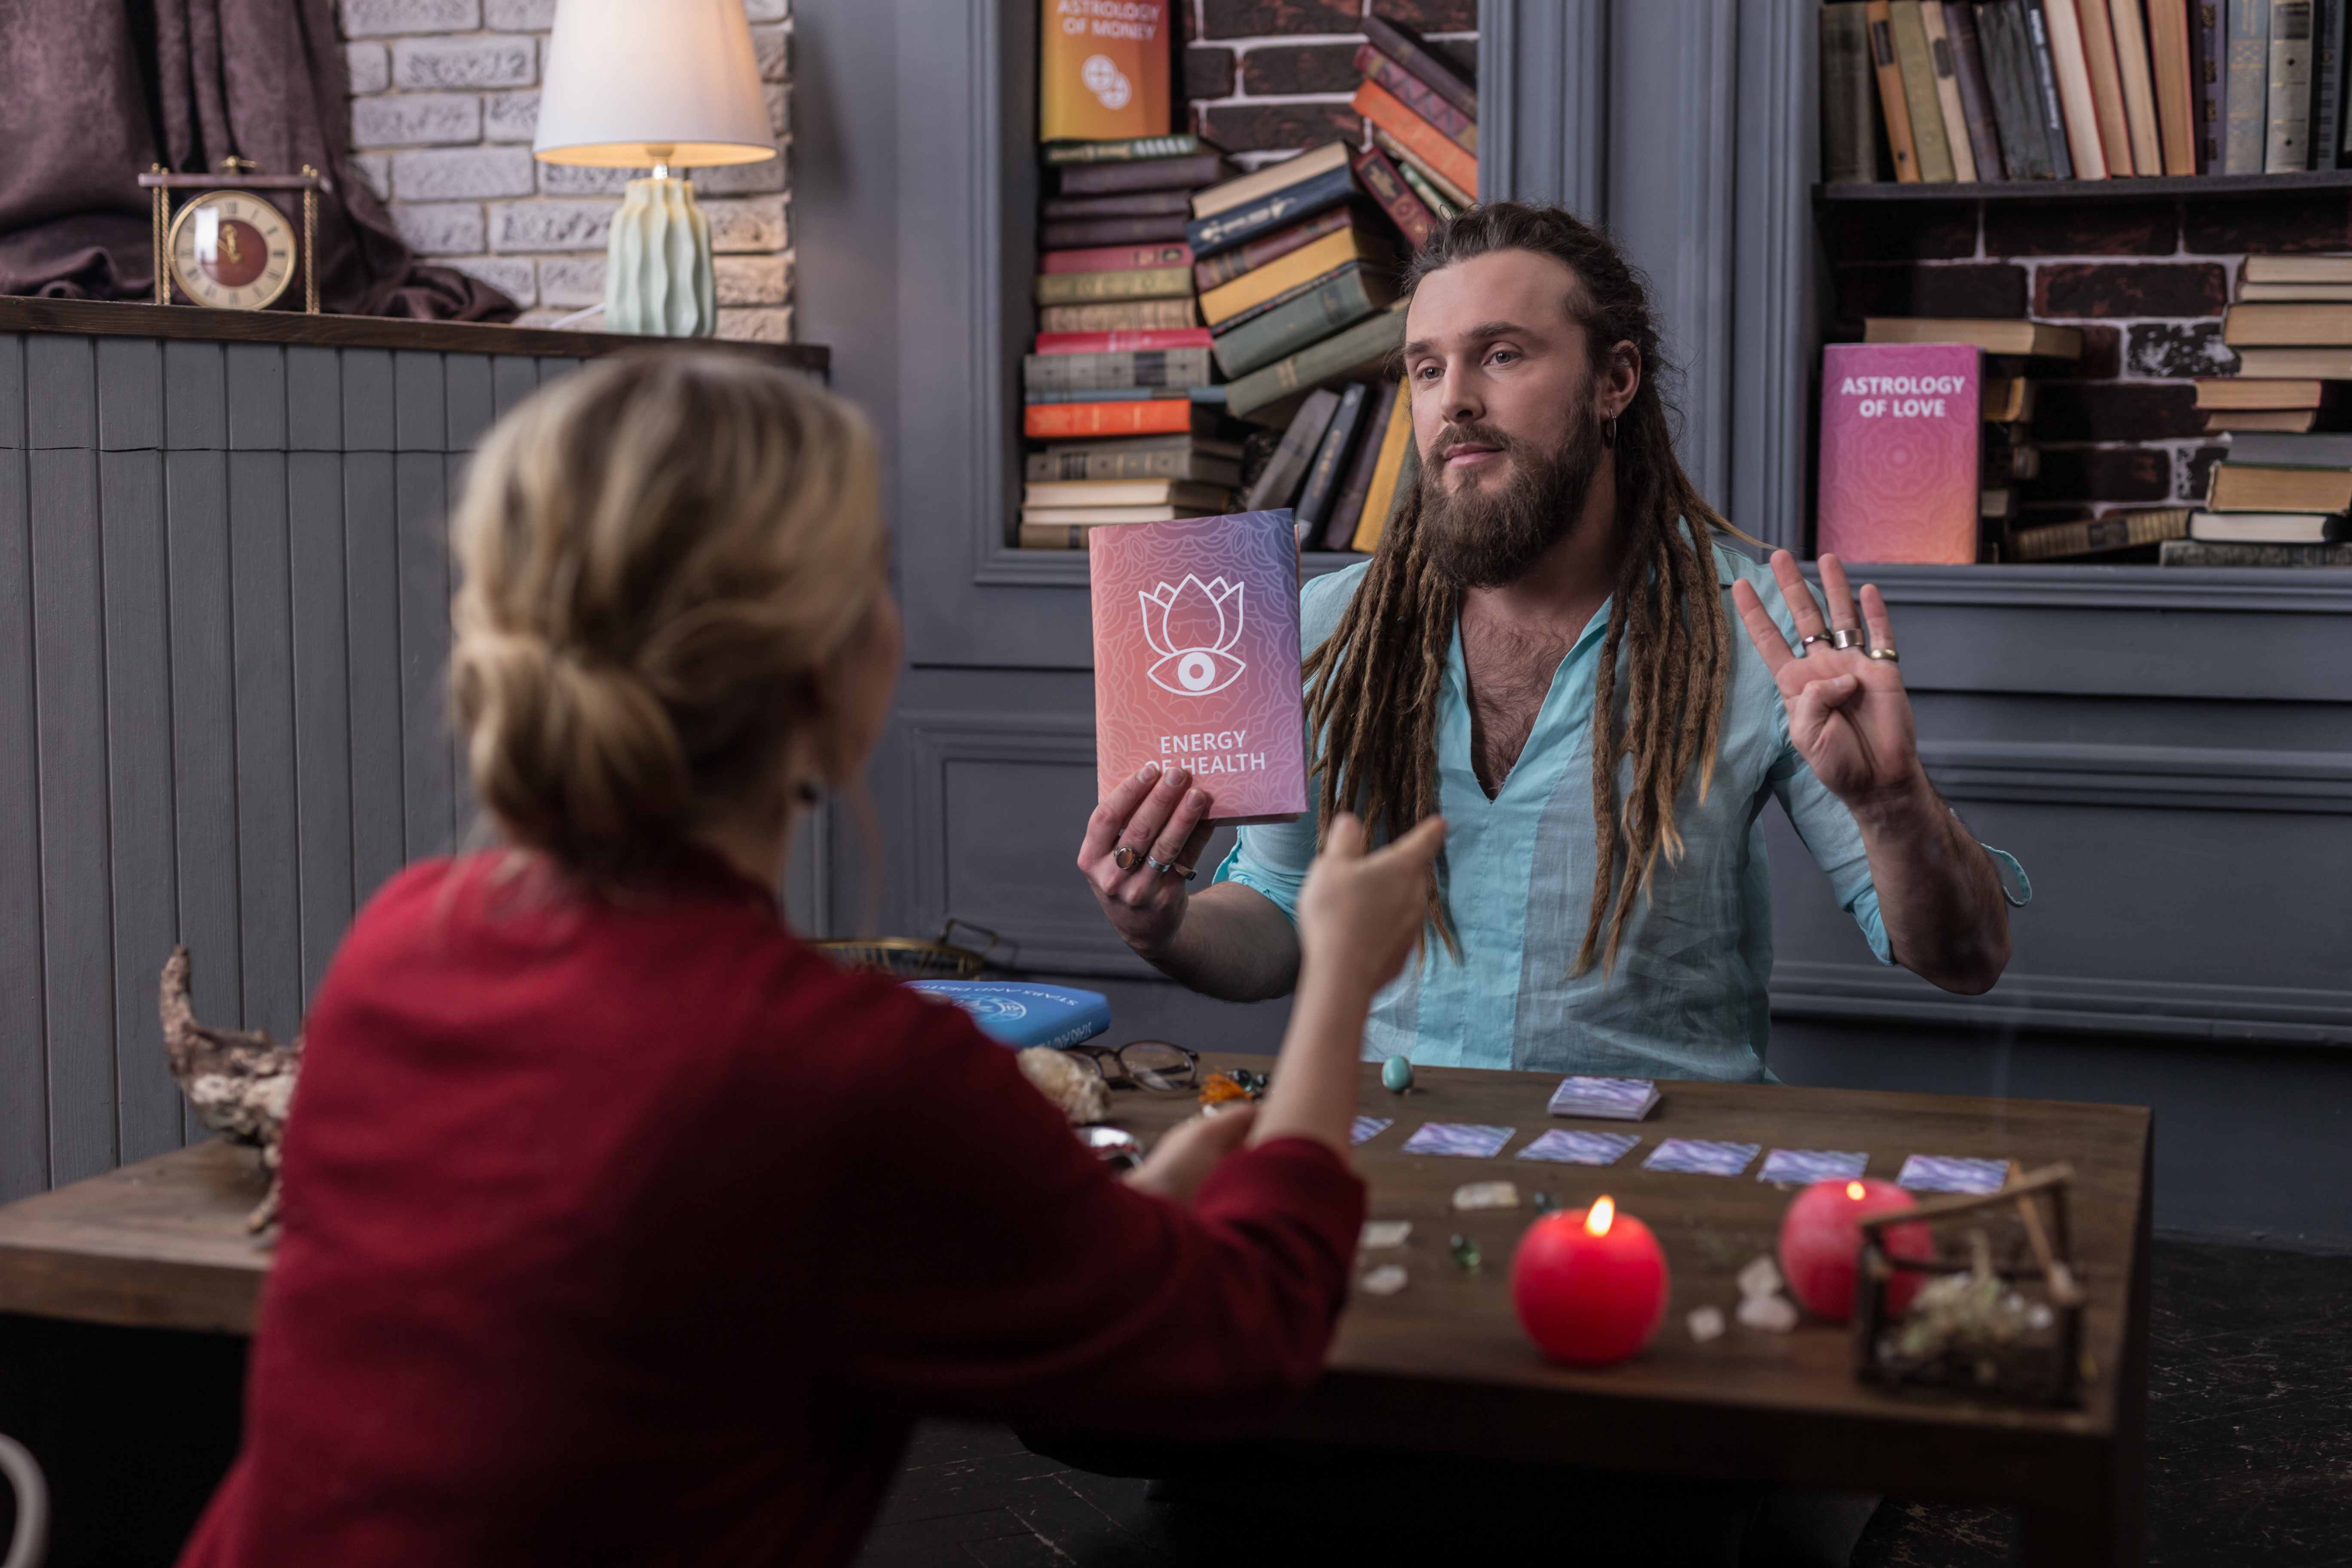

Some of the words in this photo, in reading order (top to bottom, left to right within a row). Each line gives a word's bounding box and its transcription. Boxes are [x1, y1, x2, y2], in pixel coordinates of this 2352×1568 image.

[1057, 0, 1160, 21] ASTROLOGY
[1063, 17, 1087, 35] OF
[1092, 19, 1156, 41] MONEY
[1841, 376, 1966, 395] ASTROLOGY
[1859, 399, 1887, 417] OF
[1893, 398, 1946, 417] LOVE
[1161, 730, 1246, 753] ENERGY
[1181, 752, 1265, 775] HEALTH
